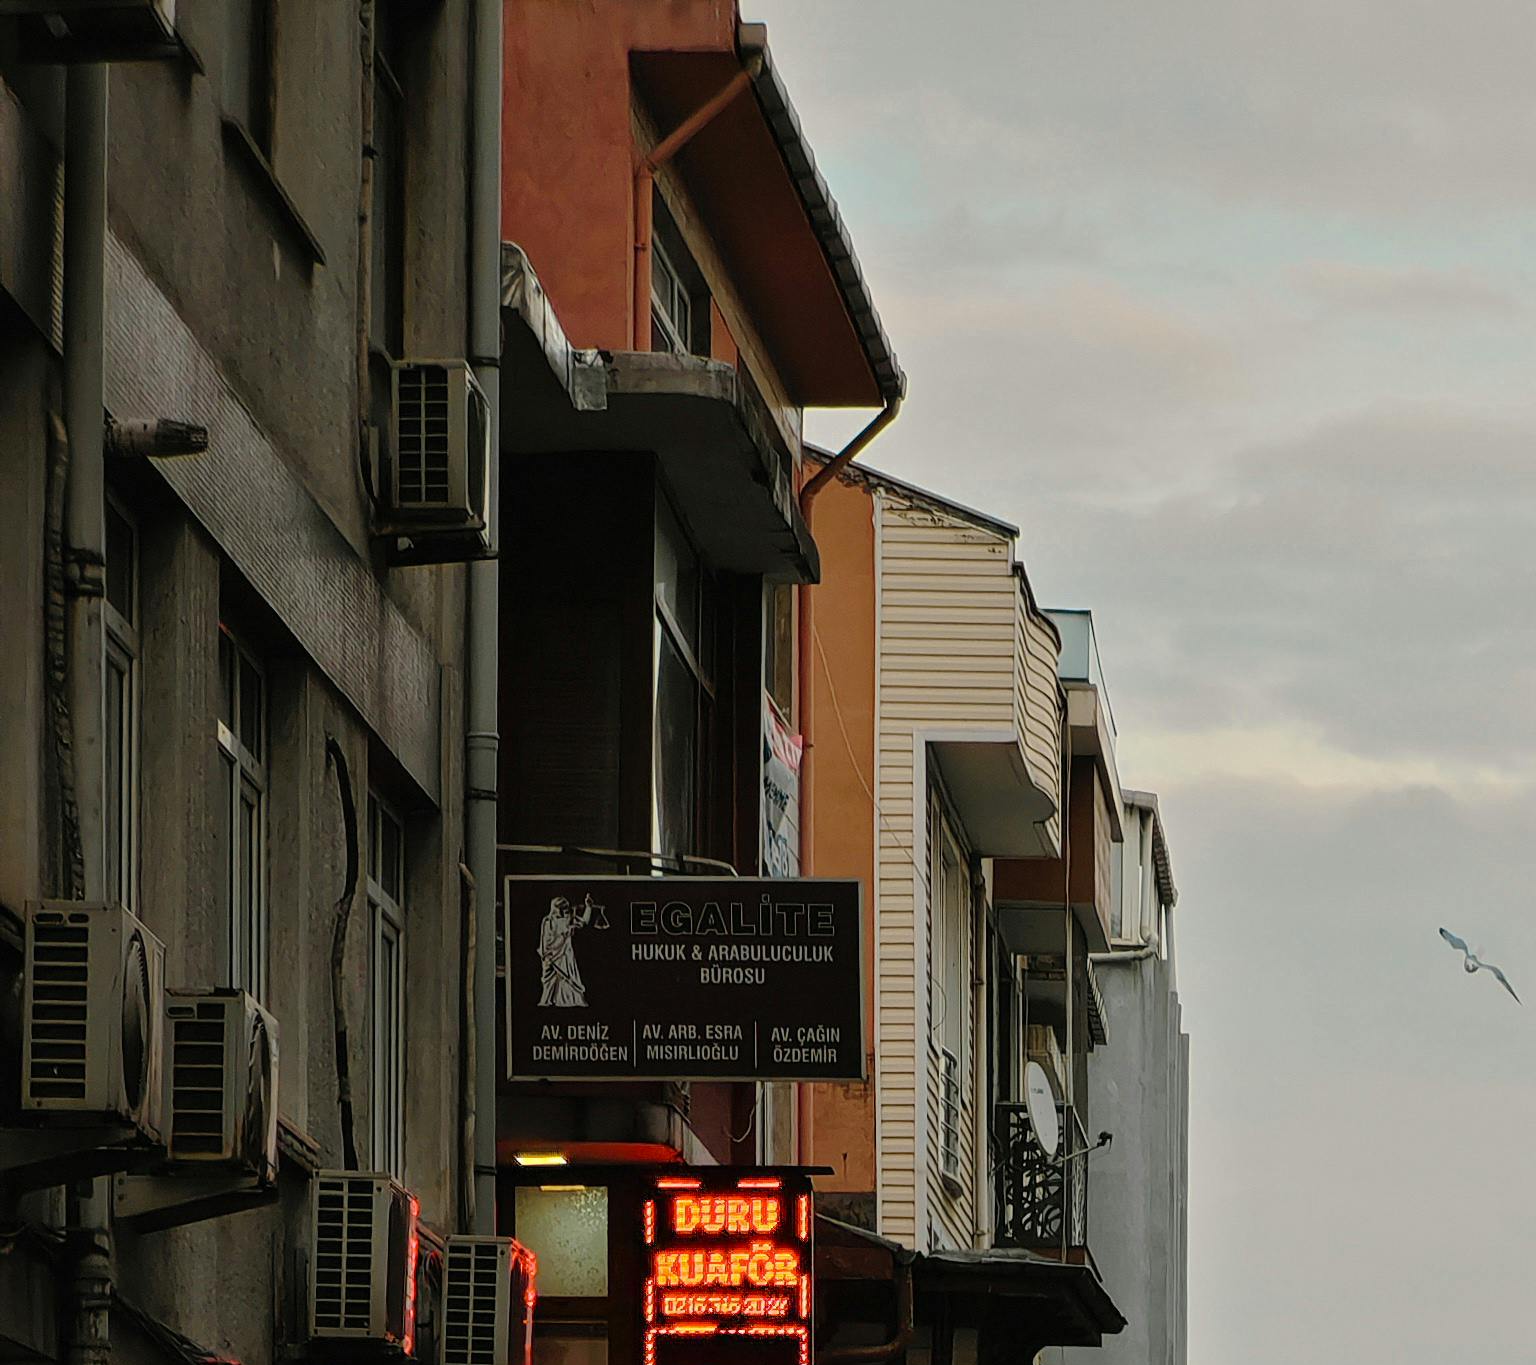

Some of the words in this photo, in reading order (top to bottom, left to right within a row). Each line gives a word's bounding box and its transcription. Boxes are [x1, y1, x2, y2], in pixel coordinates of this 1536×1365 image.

[630, 894, 835, 936] EGALİTE
[631, 944, 686, 962] HUKUK
[691, 945, 703, 961] &
[708, 945, 834, 963] ARABULUCULUK
[700, 964, 766, 985] BÜROSU
[541, 1025, 563, 1041] AV.
[568, 1021, 609, 1041] DENİZ
[643, 1025, 664, 1041] AV.
[668, 1025, 701, 1041] ARB.
[706, 1025, 742, 1041] ESRA
[771, 1027, 793, 1043] AV.
[797, 1025, 840, 1045] ÇAĞIN
[532, 1042, 628, 1062] DEMİRDÖĞEN
[646, 1041, 739, 1061] MISIRLIOĞLU
[773, 1045, 837, 1064] ÖZDEMİR
[673, 1197, 780, 1233] DURU
[655, 1242, 799, 1286] KUAFÖR
